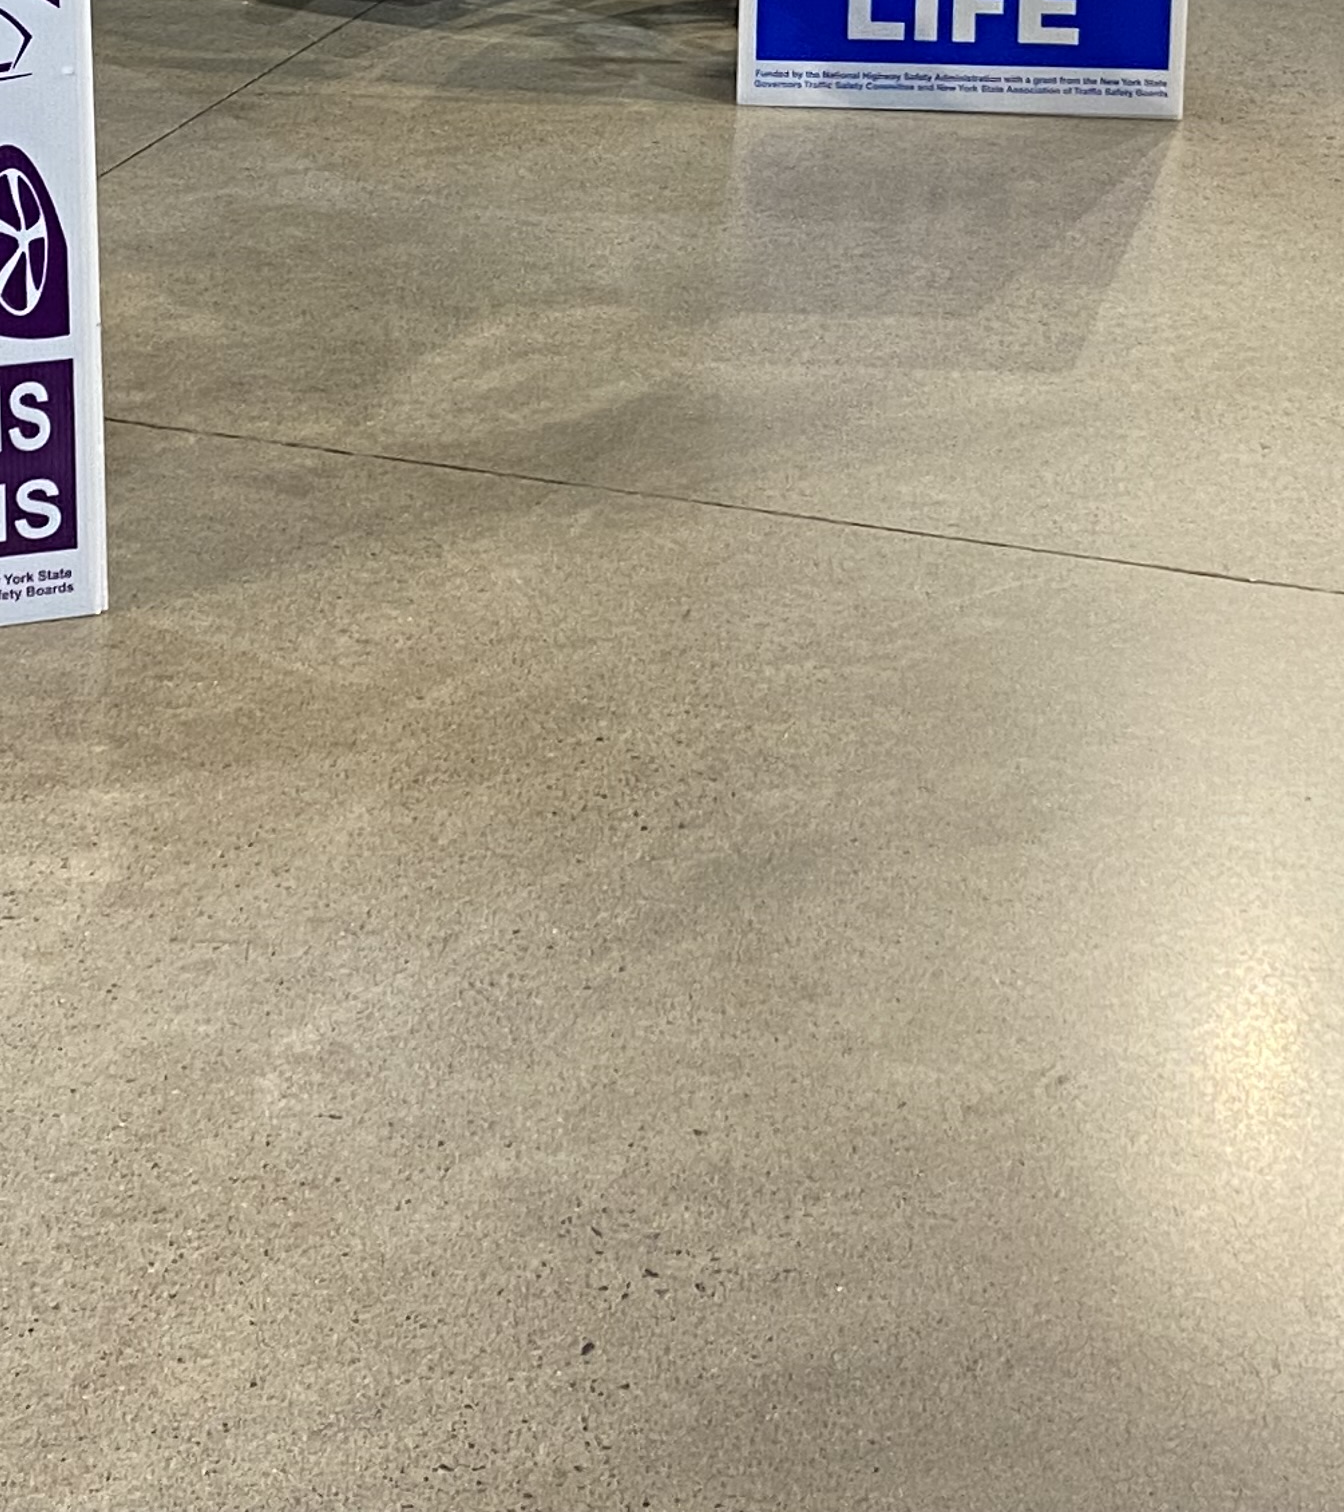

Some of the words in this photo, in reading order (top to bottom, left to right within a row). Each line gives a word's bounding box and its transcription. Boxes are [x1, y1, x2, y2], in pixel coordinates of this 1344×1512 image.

[4, 573, 34, 586] York
[38, 568, 72, 581] State
[26, 582, 74, 598] Boards
